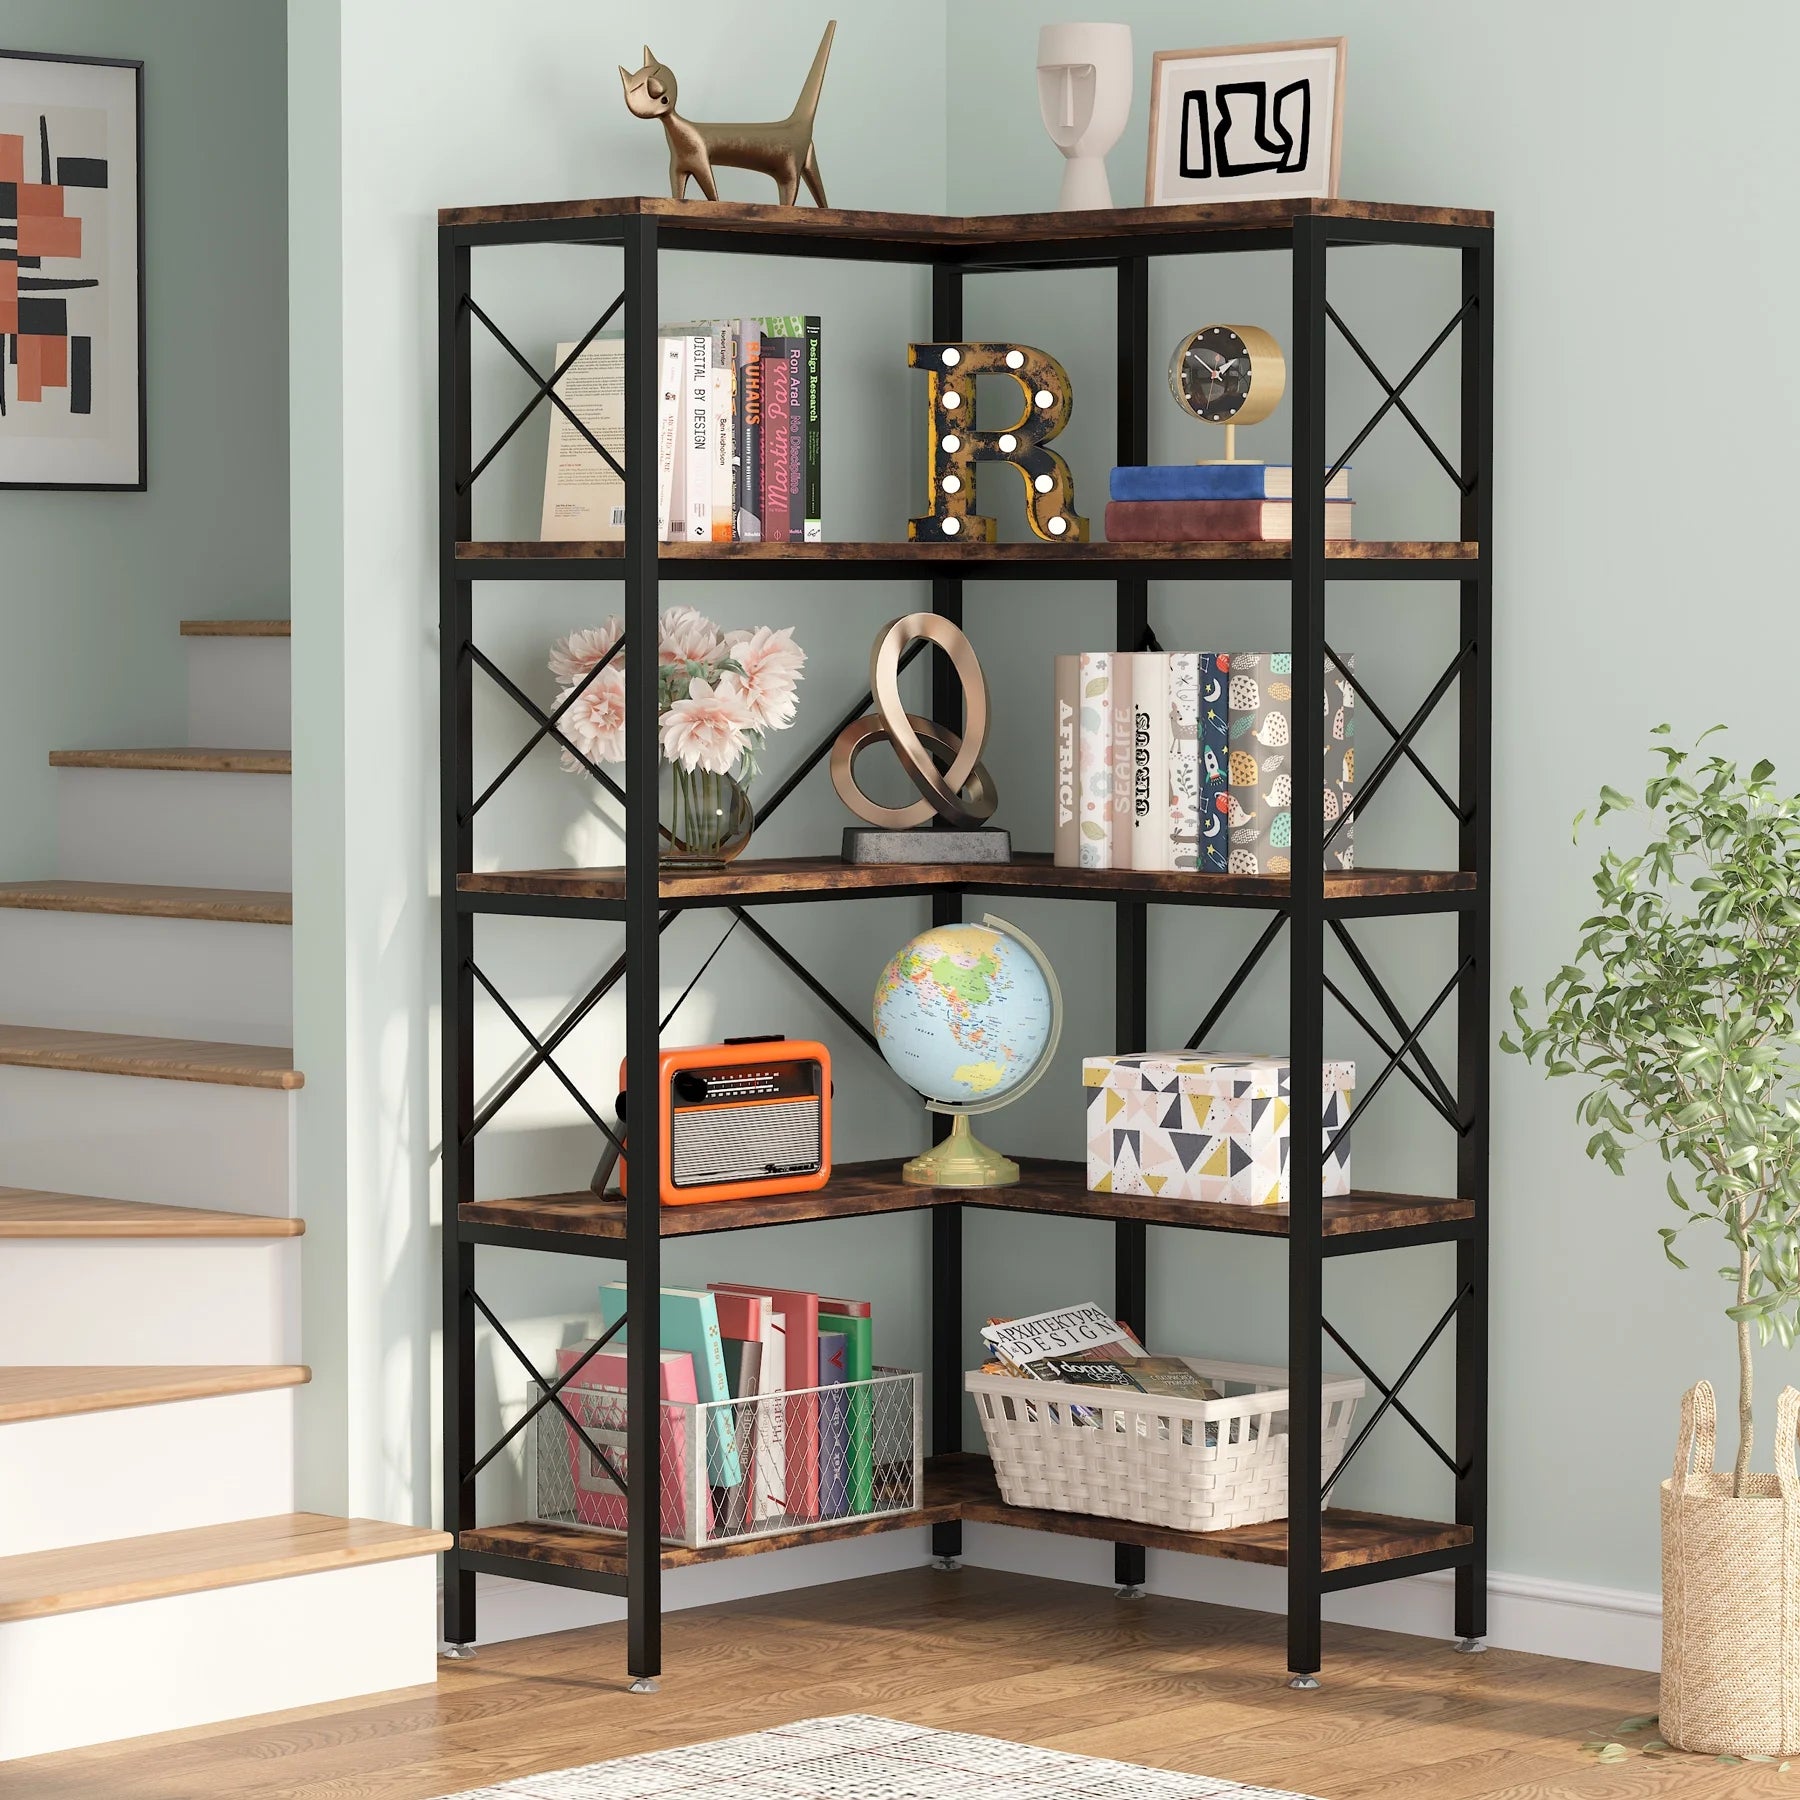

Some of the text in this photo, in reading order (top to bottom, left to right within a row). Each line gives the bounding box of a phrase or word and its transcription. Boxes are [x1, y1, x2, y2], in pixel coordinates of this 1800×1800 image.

[693, 337, 706, 450] DIGITAL BY DESIGN
[745, 342, 760, 425] BAUHAUS
[768, 362, 788, 419] Parr
[807, 338, 818, 373] Design
[790, 349, 801, 494] Ron Arad No Discipline
[809, 375, 818, 422] Research
[719, 418, 727, 466] Ben Nicholson
[768, 426, 788, 509] Martin
[907, 343, 1090, 543] R
[1060, 699, 1073, 827] AFRICA
[1114, 707, 1131, 814] SEALIFE
[1135, 712, 1151, 817] CIRCUS
[995, 1307, 1107, 1344] АРХИТЕКТУРА
[1013, 1320, 1117, 1356] DESIGN
[1060, 1360, 1122, 1375] domus
